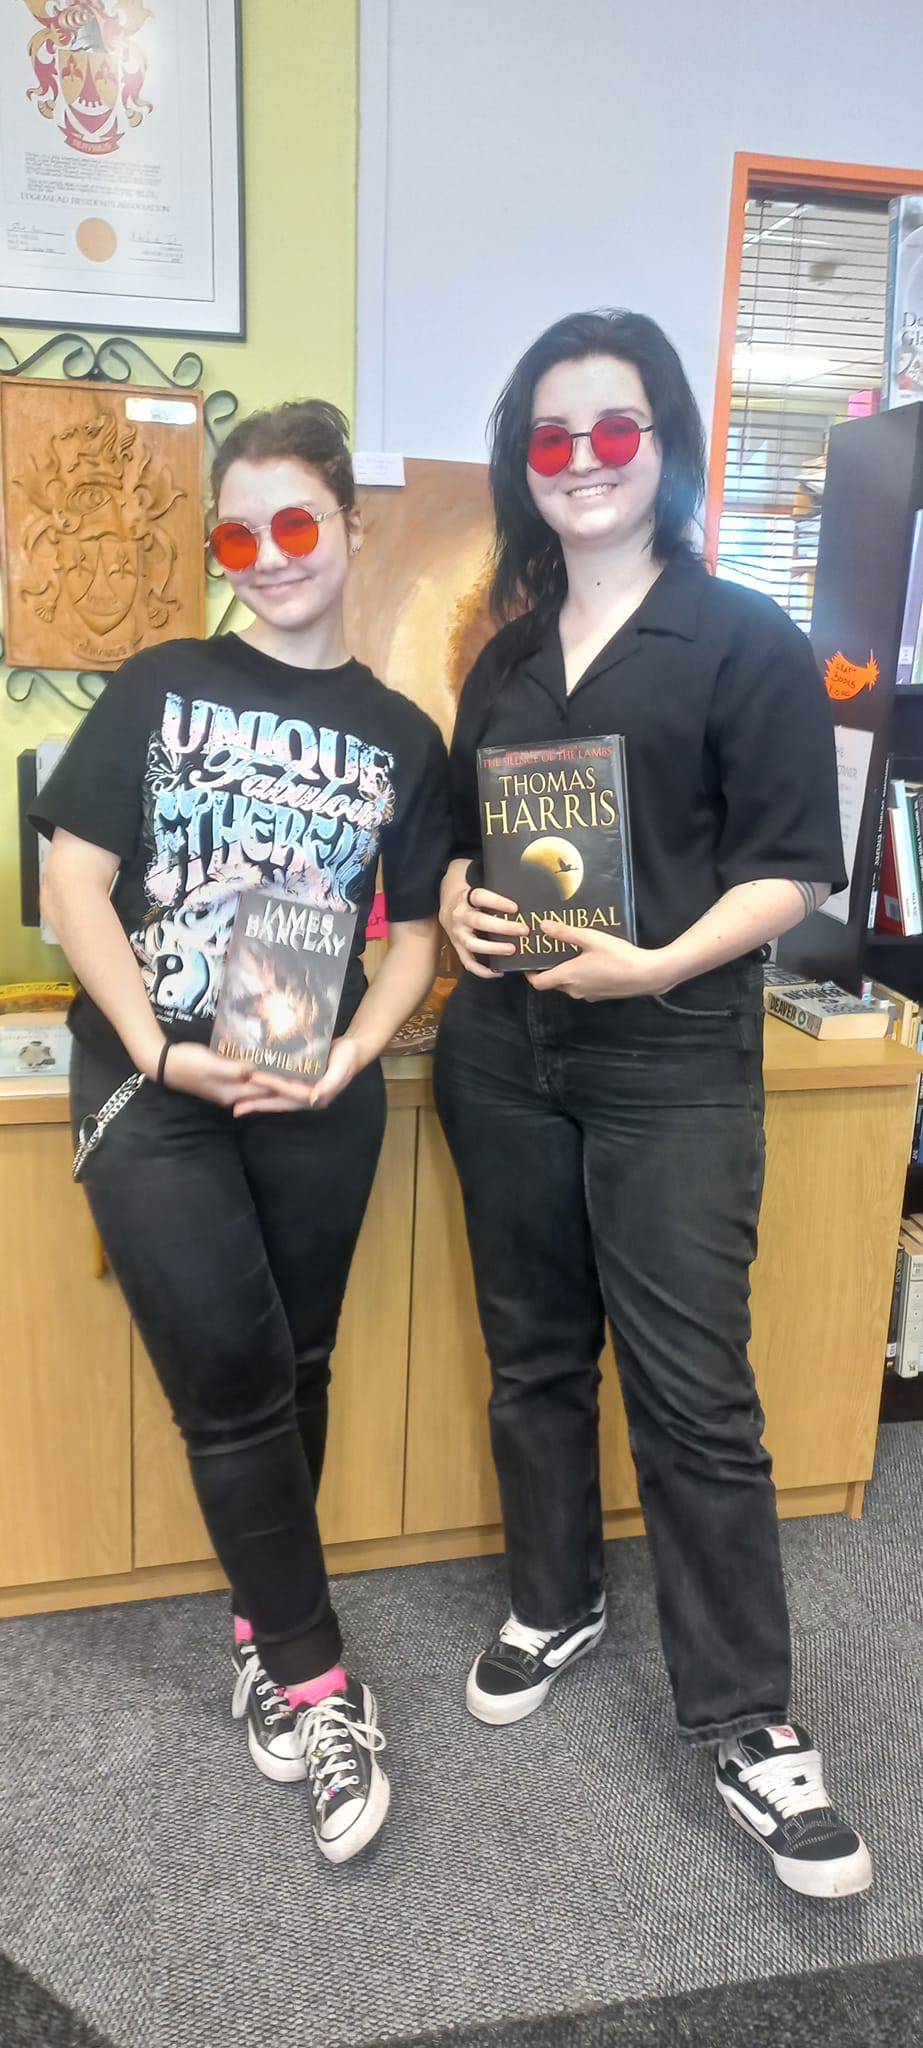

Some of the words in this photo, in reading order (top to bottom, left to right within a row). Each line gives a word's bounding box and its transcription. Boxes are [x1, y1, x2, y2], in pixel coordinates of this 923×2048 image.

[558, 749, 575, 761] THE
[578, 745, 614, 760] LAMBS
[498, 766, 597, 798] THOMAS
[484, 789, 618, 836] HARRIS
[263, 899, 335, 936] JAMES
[493, 906, 621, 931] ANNIBAL
[245, 913, 347, 958] BARCLAY
[520, 934, 579, 955] RISIN
[769, 995, 798, 1021] DEAVER
[217, 1039, 321, 1076] SHADOWHEART
